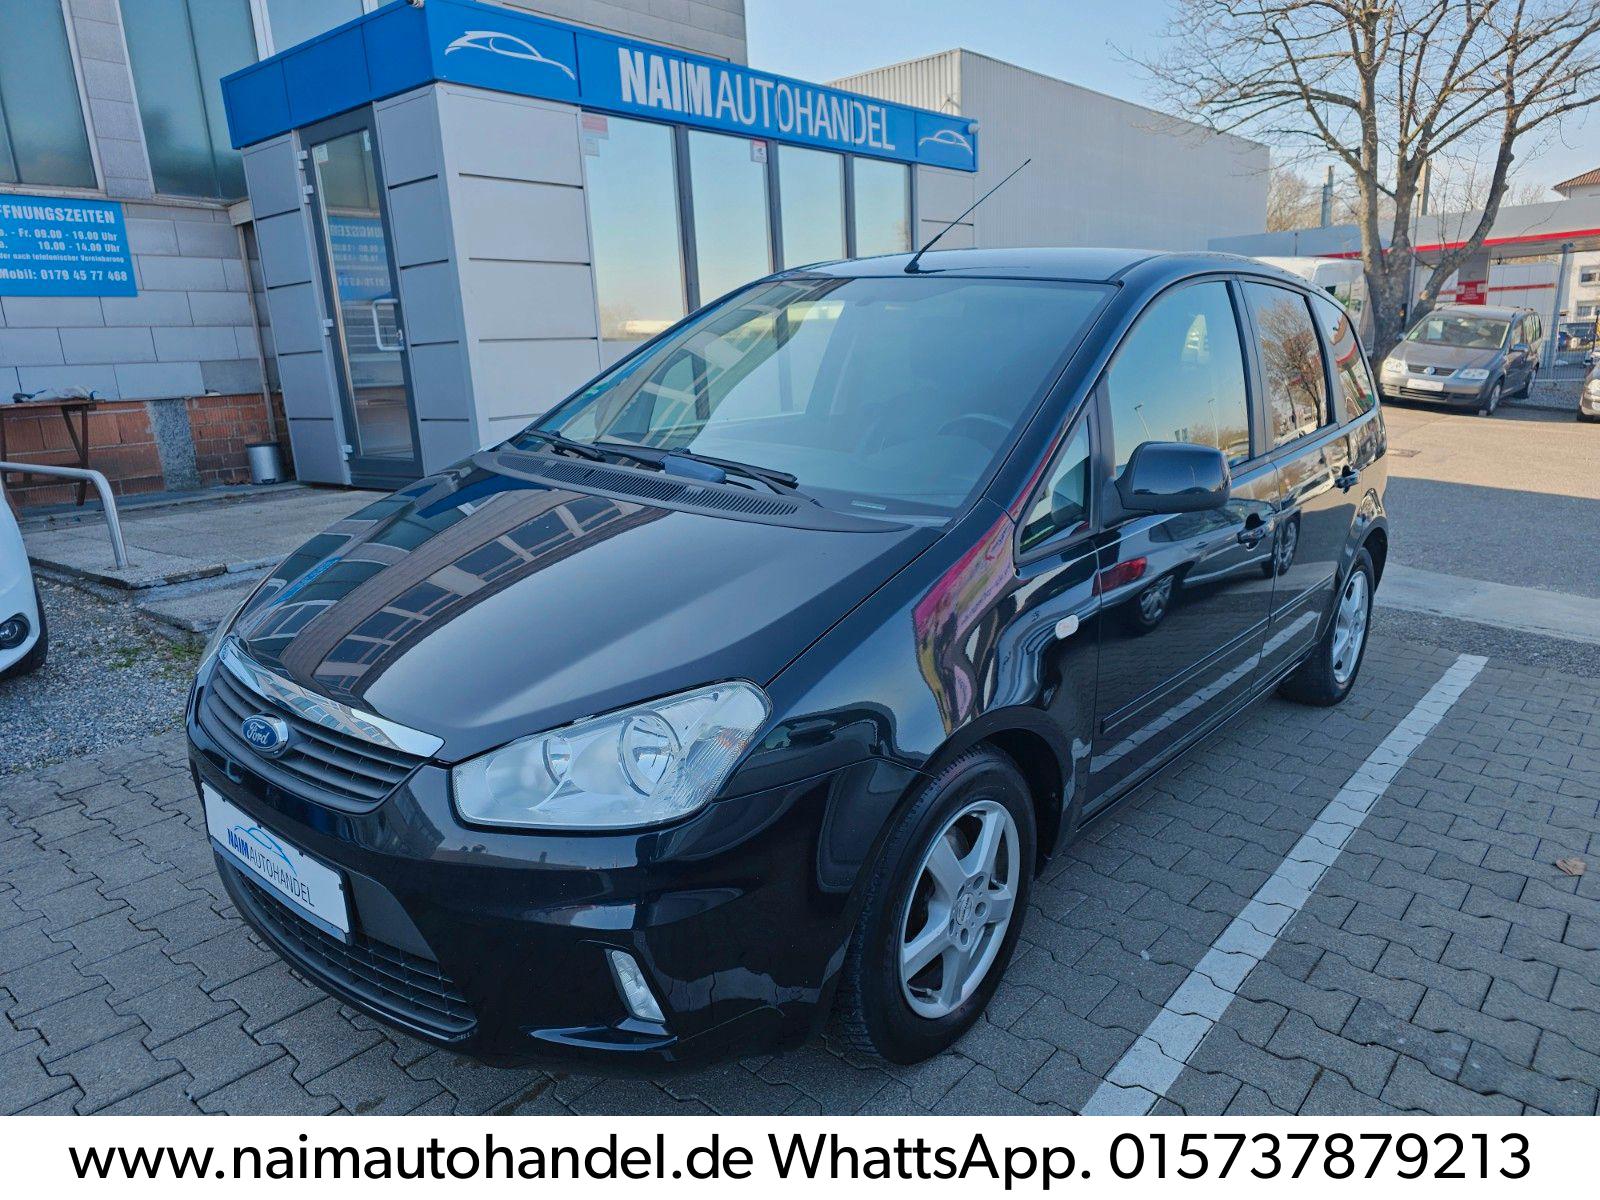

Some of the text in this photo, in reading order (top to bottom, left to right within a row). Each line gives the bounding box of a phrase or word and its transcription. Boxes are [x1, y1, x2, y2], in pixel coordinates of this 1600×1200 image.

[101, 231, 118, 242] Uhr
[104, 243, 121, 253] Uhr
[90, 270, 104, 281] 77
[247, 721, 270, 745] Ford
